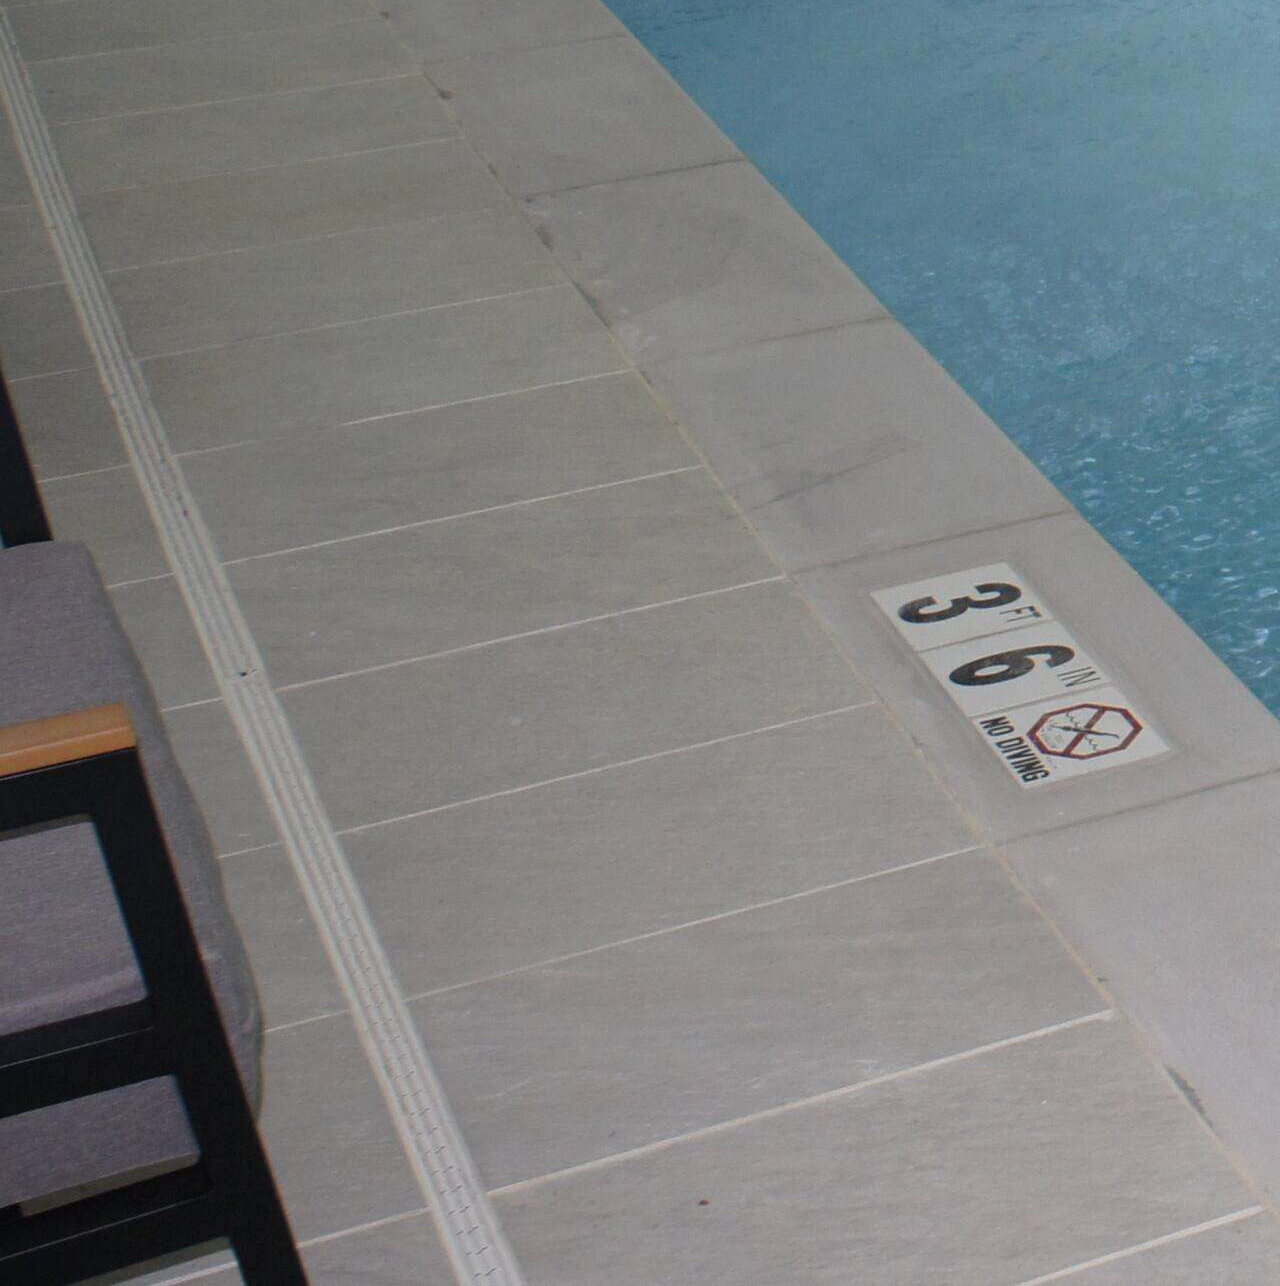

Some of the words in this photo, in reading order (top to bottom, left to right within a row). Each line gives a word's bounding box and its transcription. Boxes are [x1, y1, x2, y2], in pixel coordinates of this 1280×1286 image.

[898, 582, 1022, 624] 3
[949, 645, 1075, 686] 6
[979, 715, 1016, 737] NO
[996, 735, 1050, 784] DIVING
